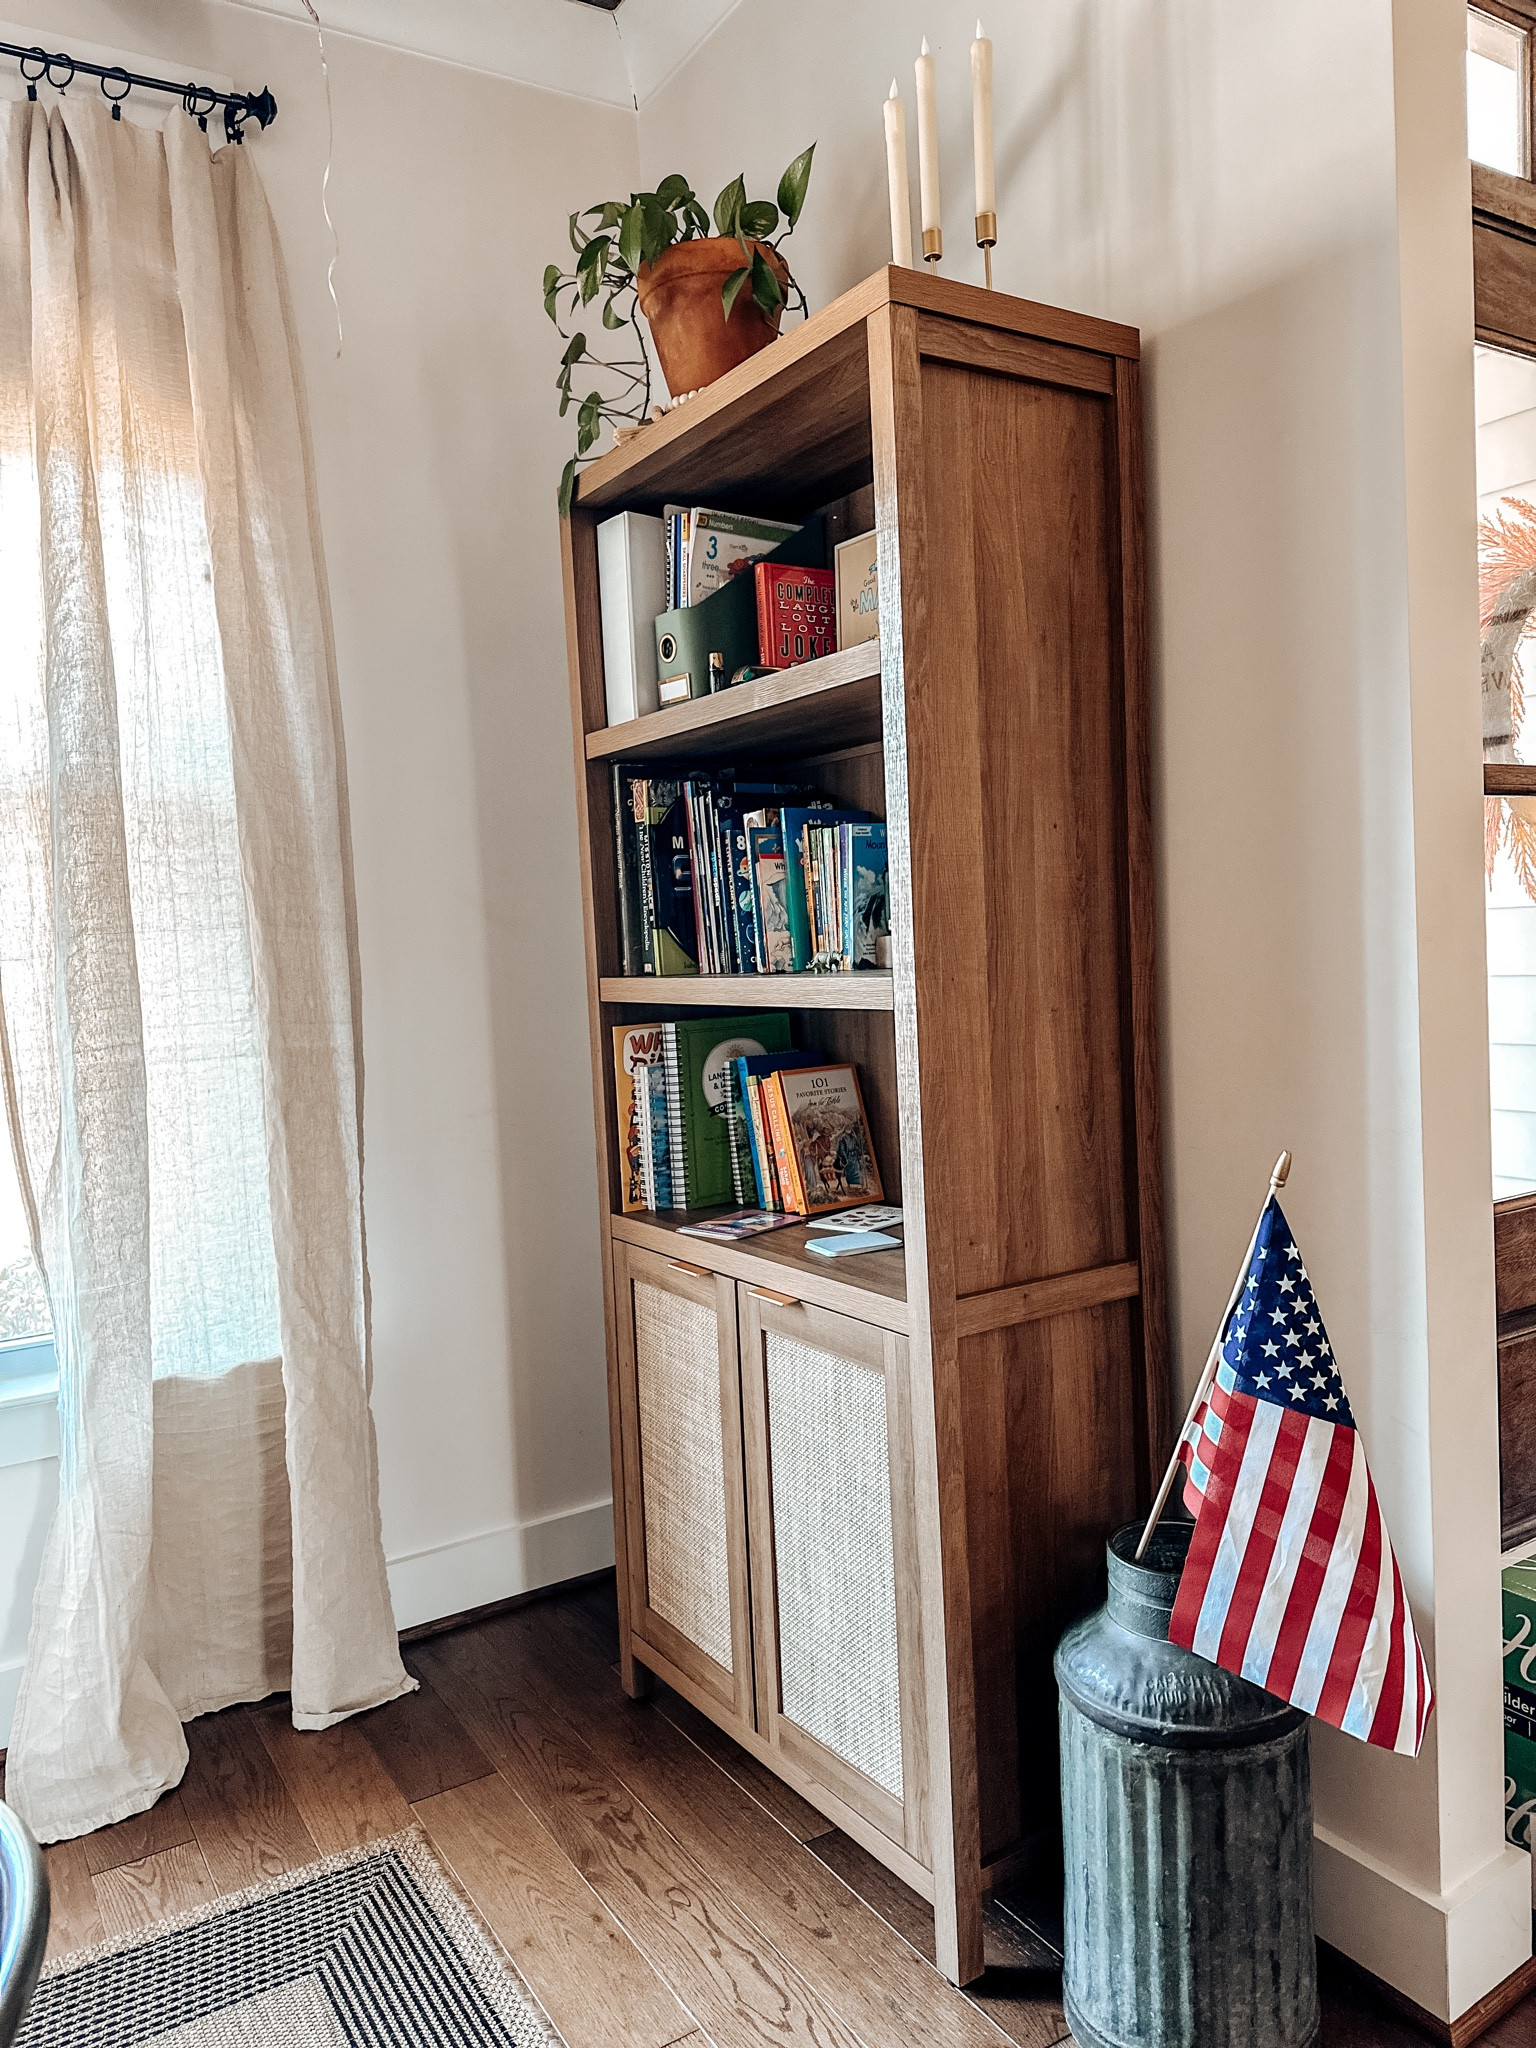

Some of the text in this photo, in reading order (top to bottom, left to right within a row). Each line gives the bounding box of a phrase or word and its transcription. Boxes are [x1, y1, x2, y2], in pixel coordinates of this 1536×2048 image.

[708, 519, 734, 531] Numbers
[706, 535, 718, 560] 3
[702, 561, 720, 573] three
[803, 576, 815, 585] The
[781, 623, 837, 636] LOU
[811, 1077, 829, 1089] 101
[796, 1086, 847, 1099] FAVORITE STORIES
[767, 1084, 782, 1143] JESUS CALLING
